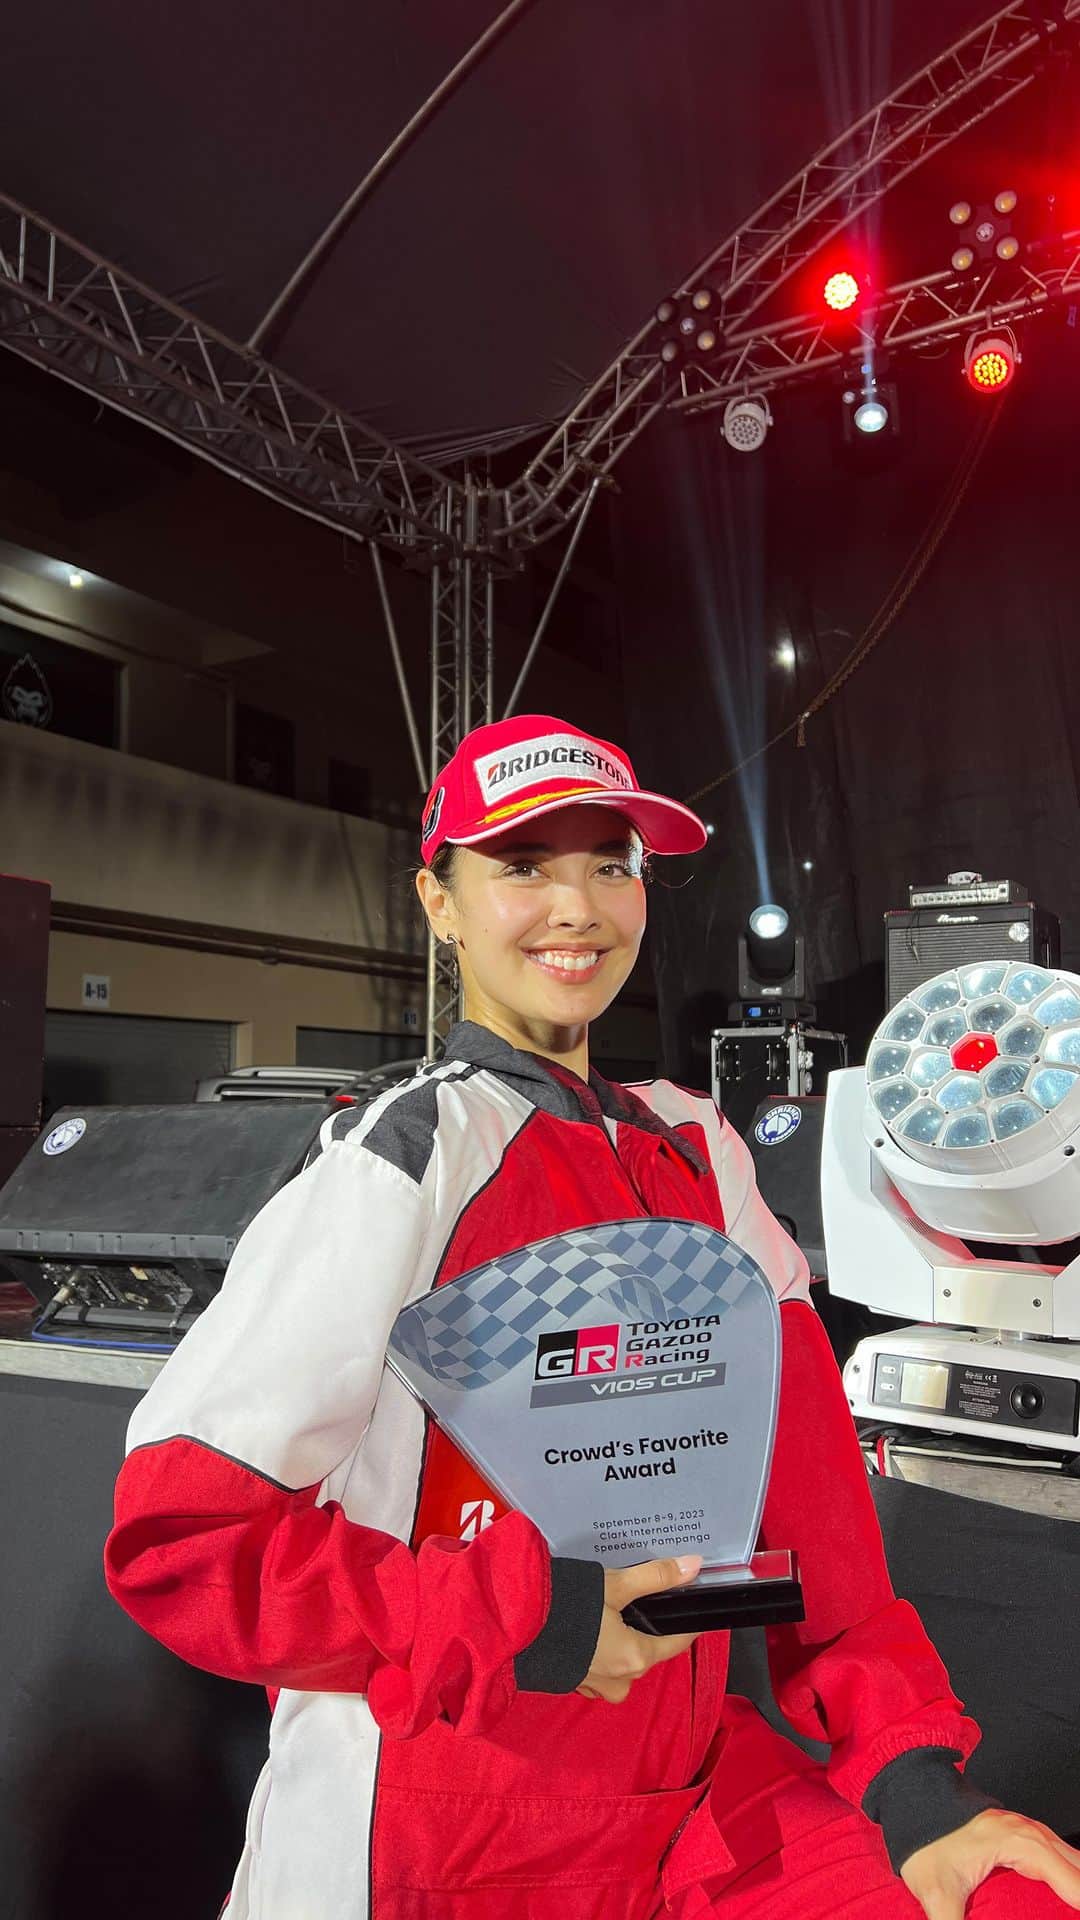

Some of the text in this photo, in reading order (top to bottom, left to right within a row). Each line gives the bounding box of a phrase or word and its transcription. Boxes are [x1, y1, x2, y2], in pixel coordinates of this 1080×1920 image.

[627, 1315, 721, 1336] TOYOTA
[626, 1332, 712, 1352] GAZOO
[537, 1344, 615, 1378] GR
[624, 1349, 710, 1369] Racing
[590, 1369, 717, 1395] VIOS CUP
[544, 1429, 729, 1466] Crowd's Favorite
[604, 1457, 676, 1482] Award
[593, 1509, 705, 1530] September 8-9, 2023
[600, 1521, 701, 1541] Clark International
[594, 1533, 711, 1554] Speedway Pampanga
